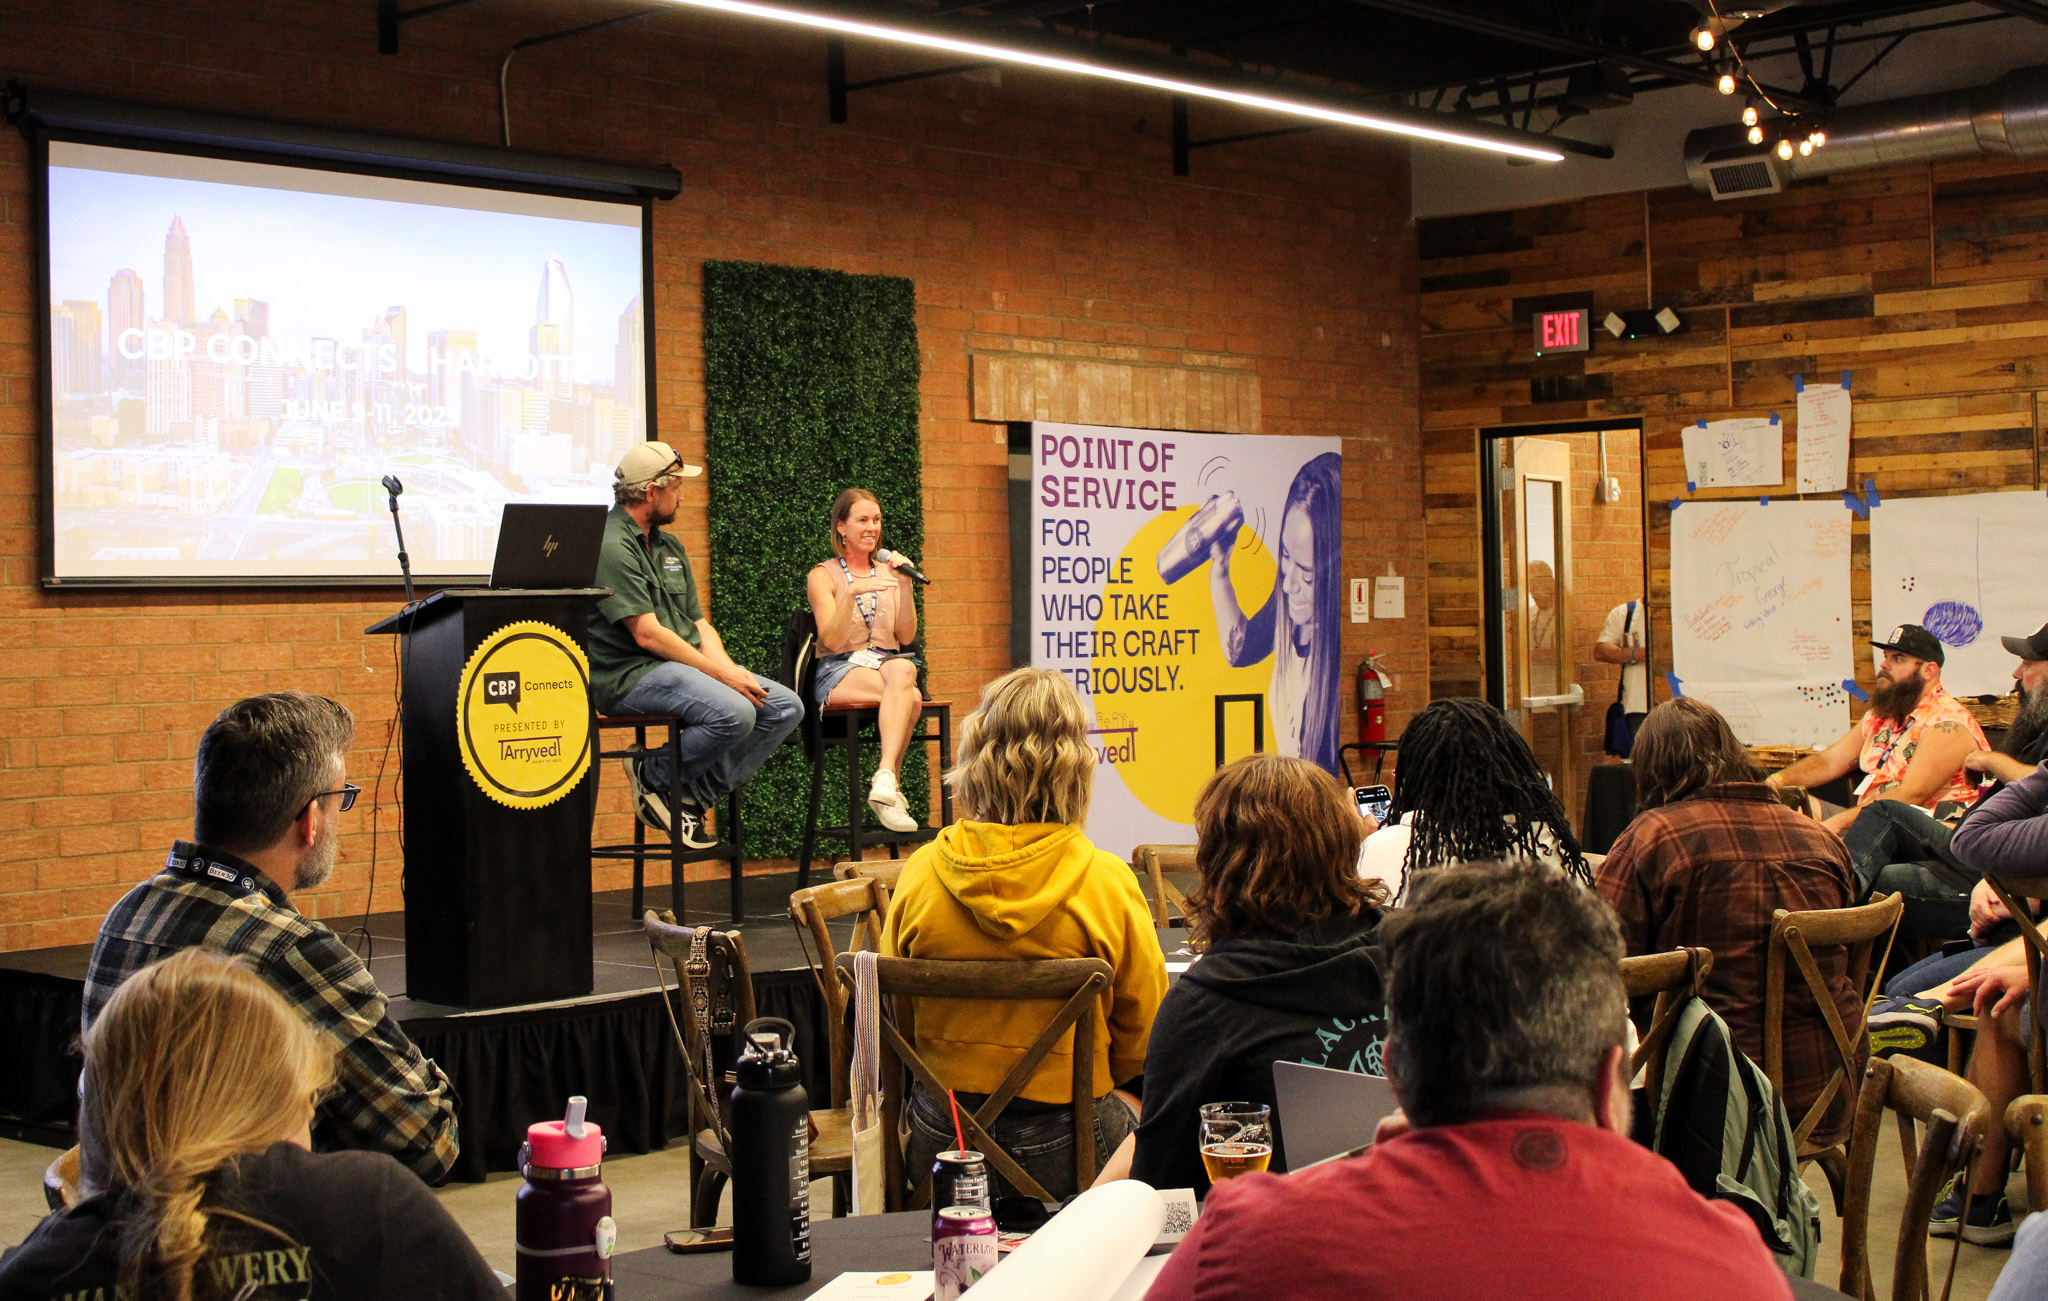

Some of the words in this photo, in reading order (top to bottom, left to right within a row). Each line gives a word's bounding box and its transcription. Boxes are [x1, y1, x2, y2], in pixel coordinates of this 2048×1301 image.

[1542, 312, 1581, 347] EXIT
[118, 328, 196, 361] CBP
[206, 333, 398, 374] CONNECTS
[408, 346, 591, 384] CHARLOTTE
[280, 399, 346, 420] JUNE
[352, 402, 399, 427] 9-11,
[404, 404, 461, 427] 2025
[1041, 434, 1134, 471] POINT
[1138, 441, 1176, 473] OF
[1041, 474, 1177, 511] SERVICE
[1042, 518, 1091, 547] FOR
[1042, 556, 1134, 584] PEOPLE
[1041, 594, 1104, 621] WHO
[1110, 594, 1169, 621] TAKE
[1041, 630, 1117, 659] THEIR
[1123, 629, 1200, 657] CRAFT
[488, 679, 517, 697] CBP
[525, 679, 573, 691] Connects
[1046, 665, 1184, 695] RIOUSLY.
[494, 720, 548, 733] PRESENTED
[554, 719, 565, 730] BY
[502, 741, 560, 763] Arryved
[939, 1240, 994, 1266] WATERLOO
